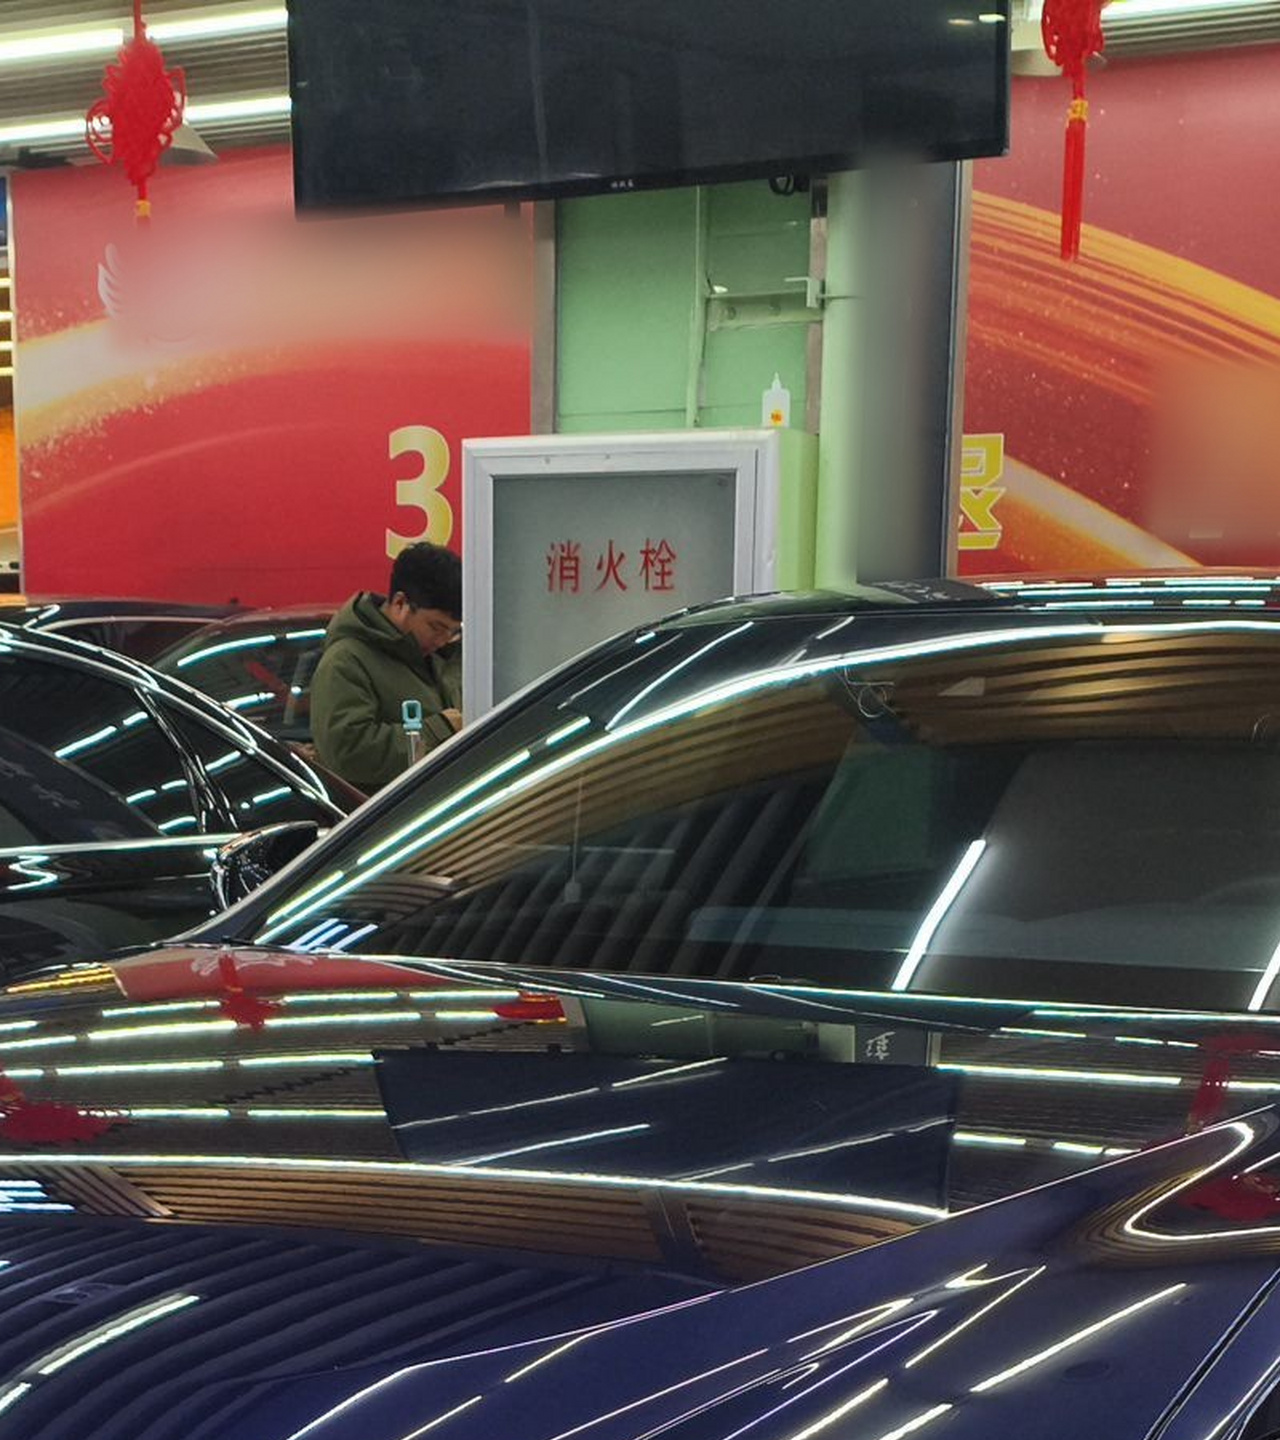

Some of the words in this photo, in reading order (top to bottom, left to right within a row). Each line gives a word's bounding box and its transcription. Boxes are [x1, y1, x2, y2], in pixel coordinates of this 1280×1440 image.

[385, 425, 453, 561] 3
[546, 538, 677, 594] 消火栓
